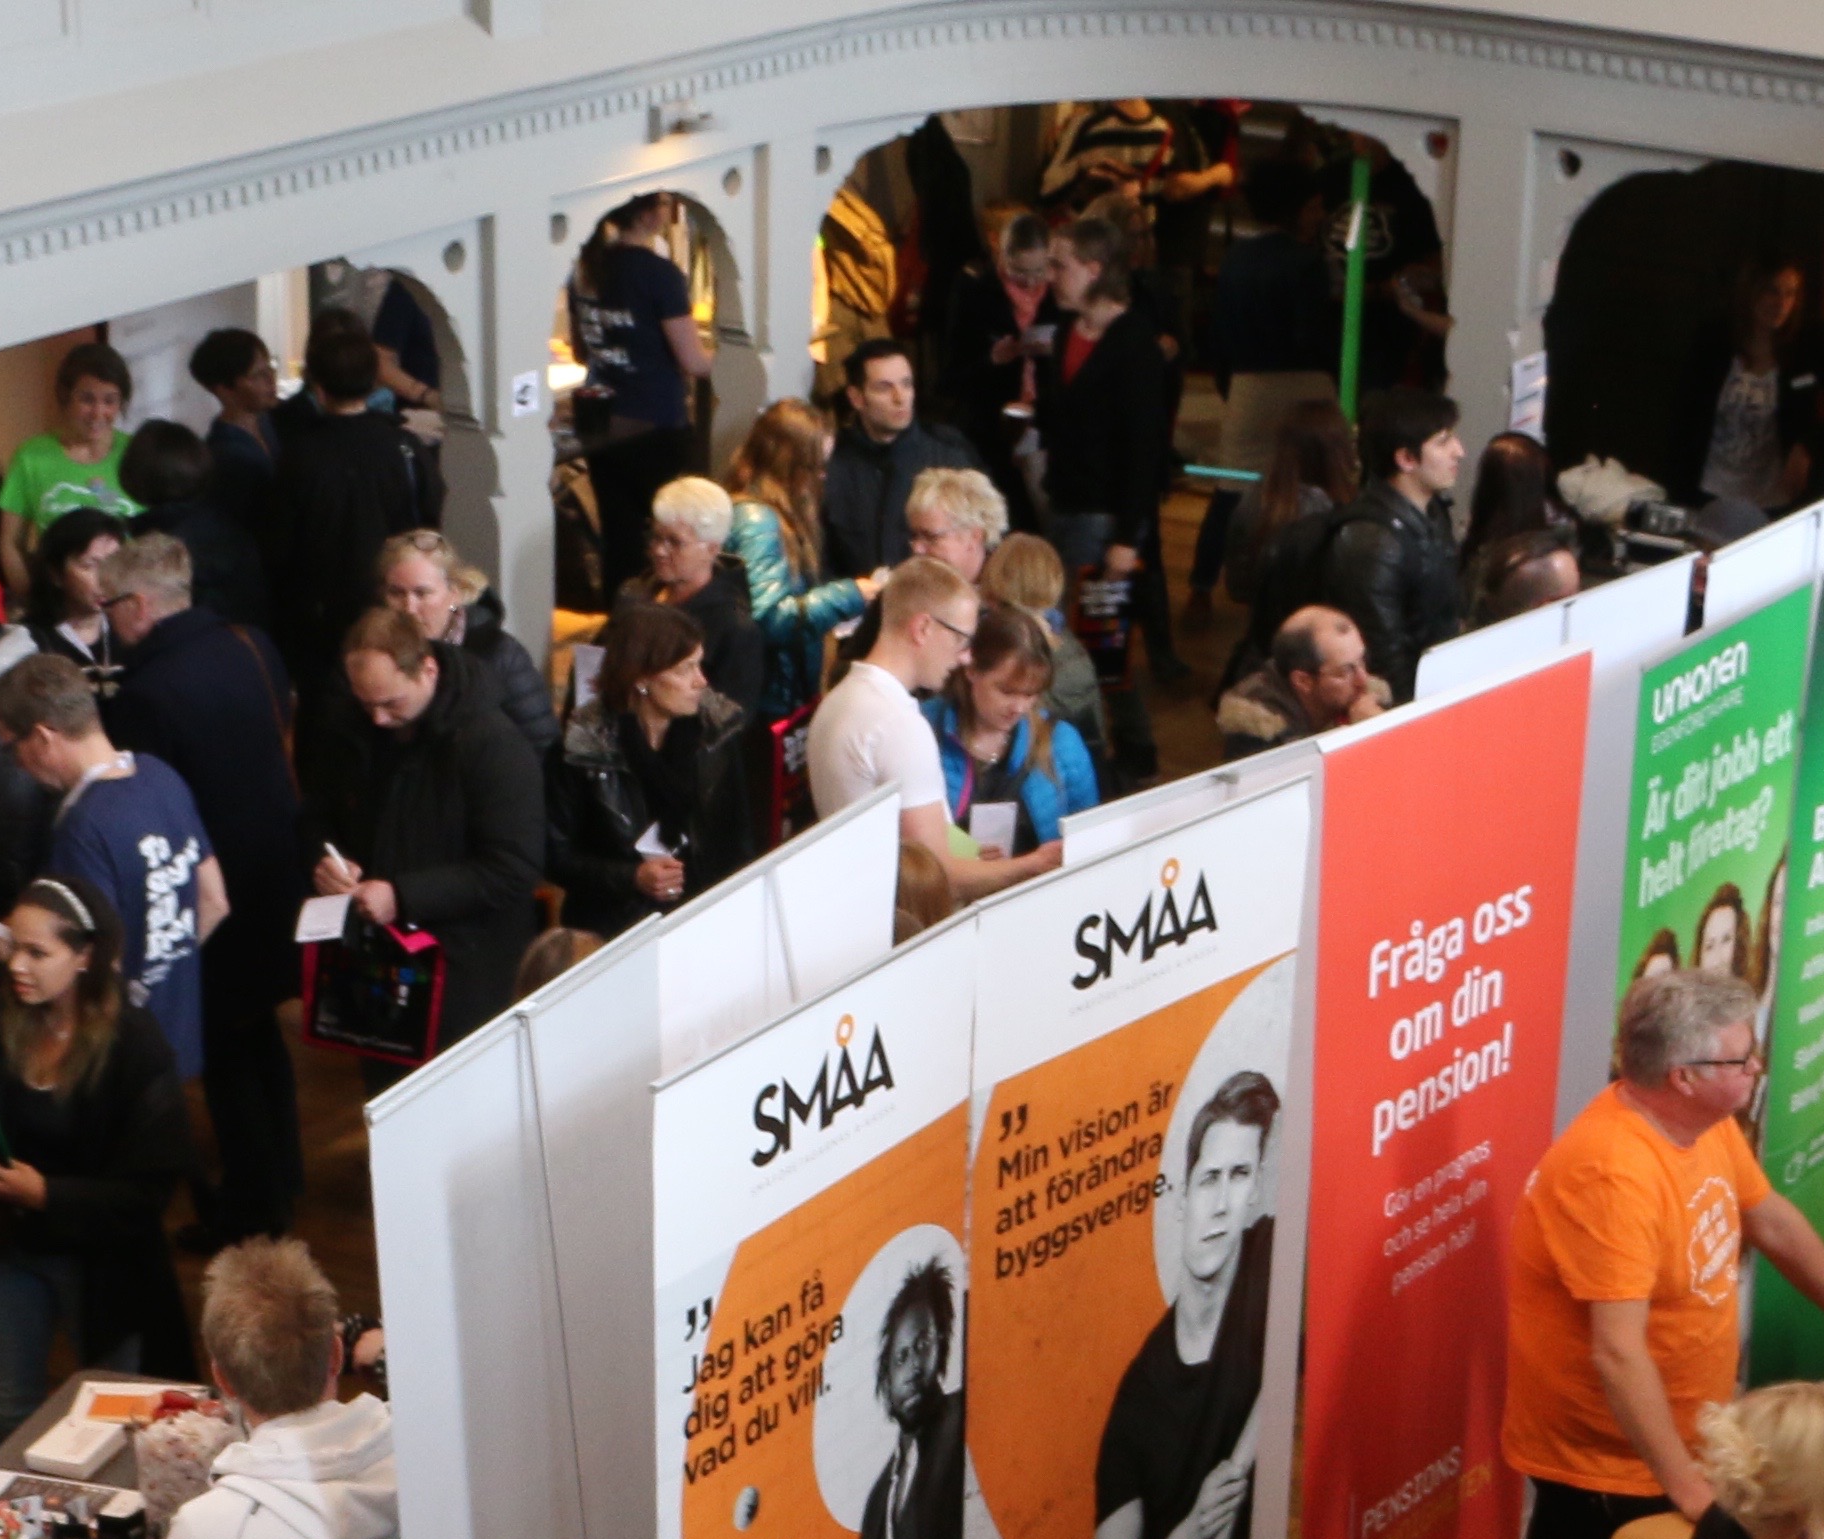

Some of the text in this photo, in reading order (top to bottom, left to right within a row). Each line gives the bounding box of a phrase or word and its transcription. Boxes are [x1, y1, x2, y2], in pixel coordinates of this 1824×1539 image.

[1707, 727, 1762, 809] jobb
[1762, 709, 1795, 765] ett
[1071, 857, 1218, 990] SMÅA
[1638, 839, 1685, 908] helt
[1368, 884, 1534, 1000] Fråga oss
[1389, 965, 1504, 1061] om din
[751, 1013, 894, 1167] SMÅA
[998, 1081, 1175, 1189] Min vision är
[1371, 1021, 1515, 1157] pension!
[995, 1132, 1163, 1235] att förändra
[995, 1171, 1174, 1280] byggsverige.
[682, 1269, 826, 1394] Jag kan få
[683, 1312, 844, 1440] dig att göra
[683, 1362, 832, 1486] vad du vill.
